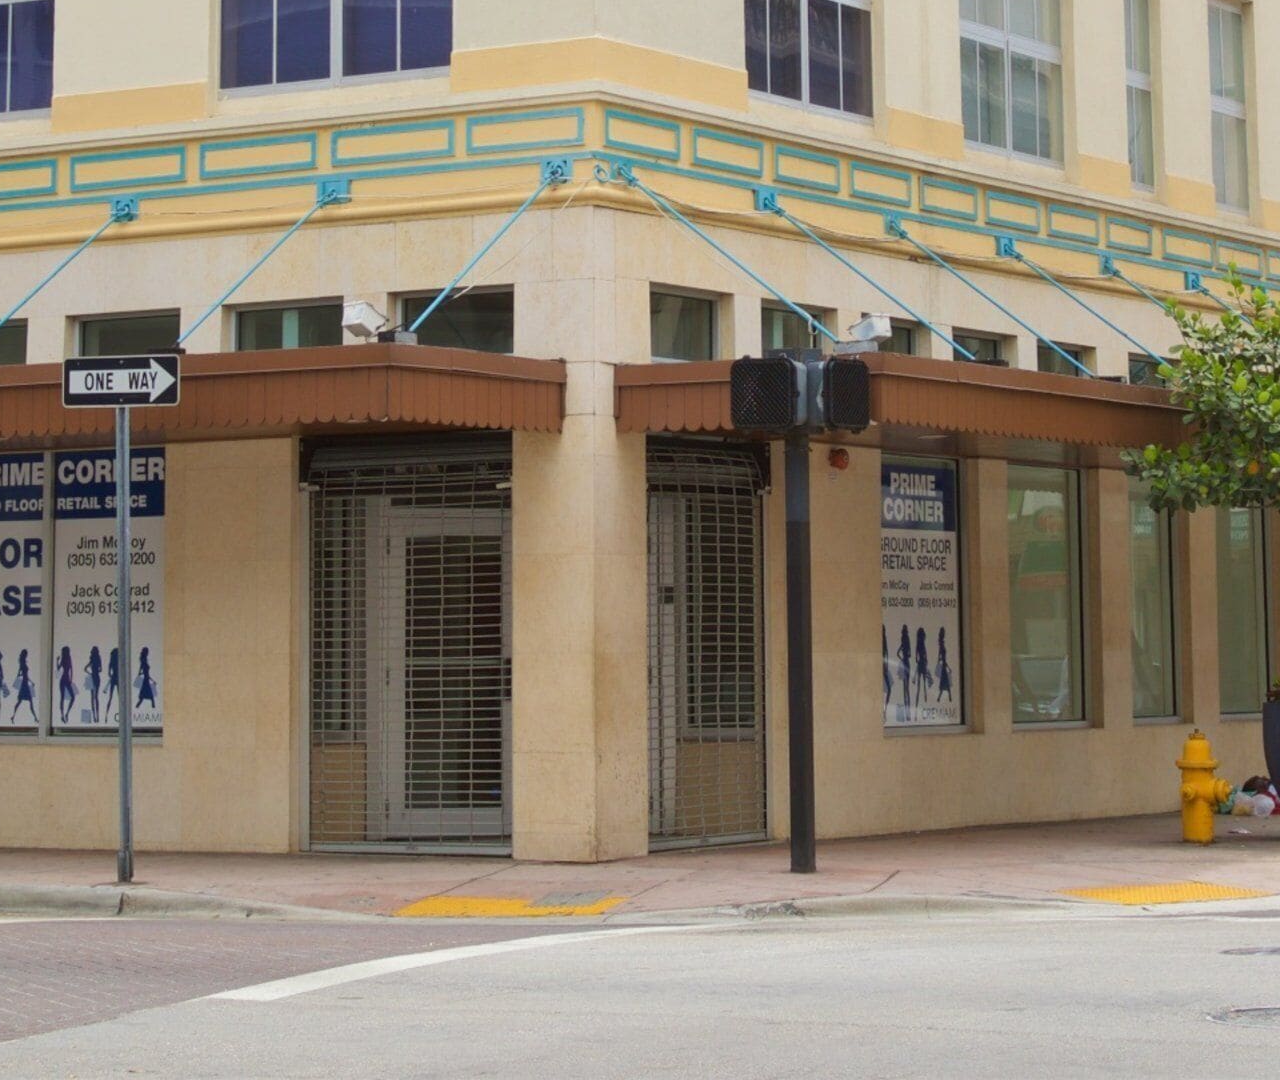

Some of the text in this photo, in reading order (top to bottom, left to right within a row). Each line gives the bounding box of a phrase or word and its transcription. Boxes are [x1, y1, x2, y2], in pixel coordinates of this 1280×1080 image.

[84, 371, 158, 391] ONE WAY
[58, 457, 165, 485] CORER
[890, 472, 936, 496] PRIME
[57, 496, 101, 510] RETAIL
[105, 495, 147, 509] SCE
[883, 497, 944, 523] CORNER
[76, 535, 146, 551] Jim Moy
[921, 538, 952, 555] FLOOR
[67, 551, 156, 569] (305) 63200
[882, 554, 947, 571] RETAIL SPACE
[71, 582, 150, 598] Jack Crad
[66, 600, 155, 617] (305) 613412
